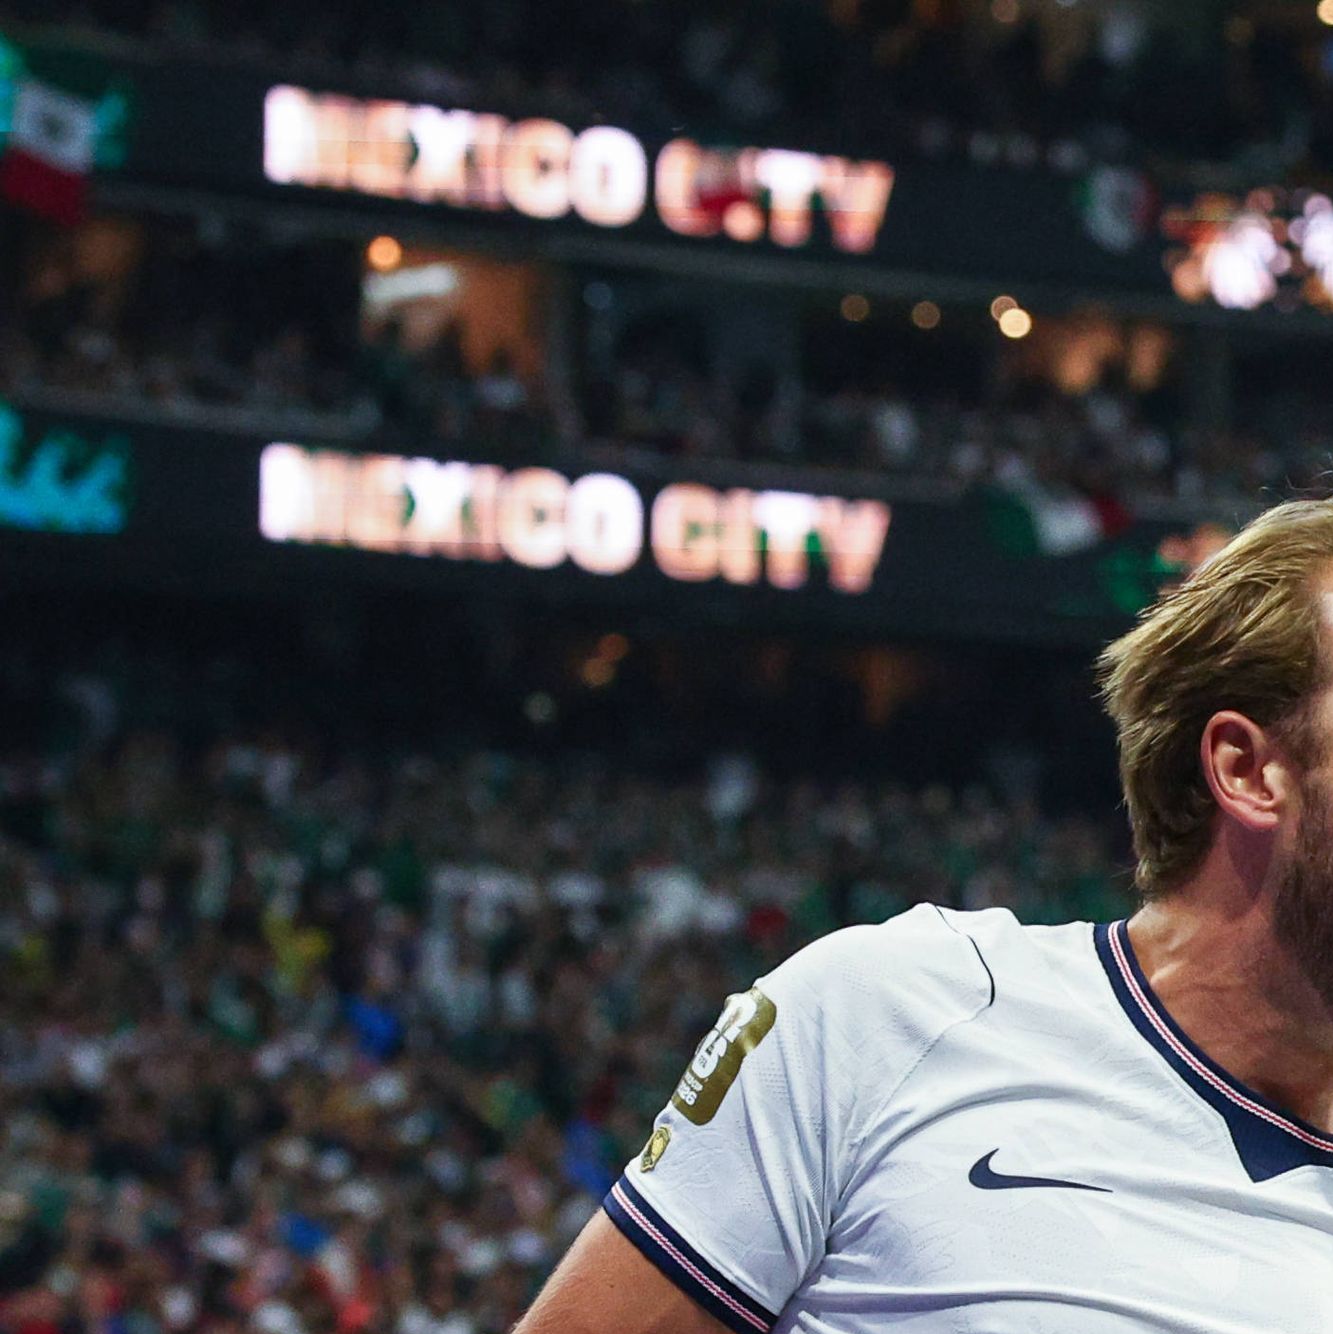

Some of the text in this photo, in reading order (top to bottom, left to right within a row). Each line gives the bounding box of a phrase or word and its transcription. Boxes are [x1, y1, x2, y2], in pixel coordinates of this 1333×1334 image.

[264, 84, 648, 227] MEXICO
[259, 442, 643, 576] MEXICO
[650, 482, 890, 594] CITY
